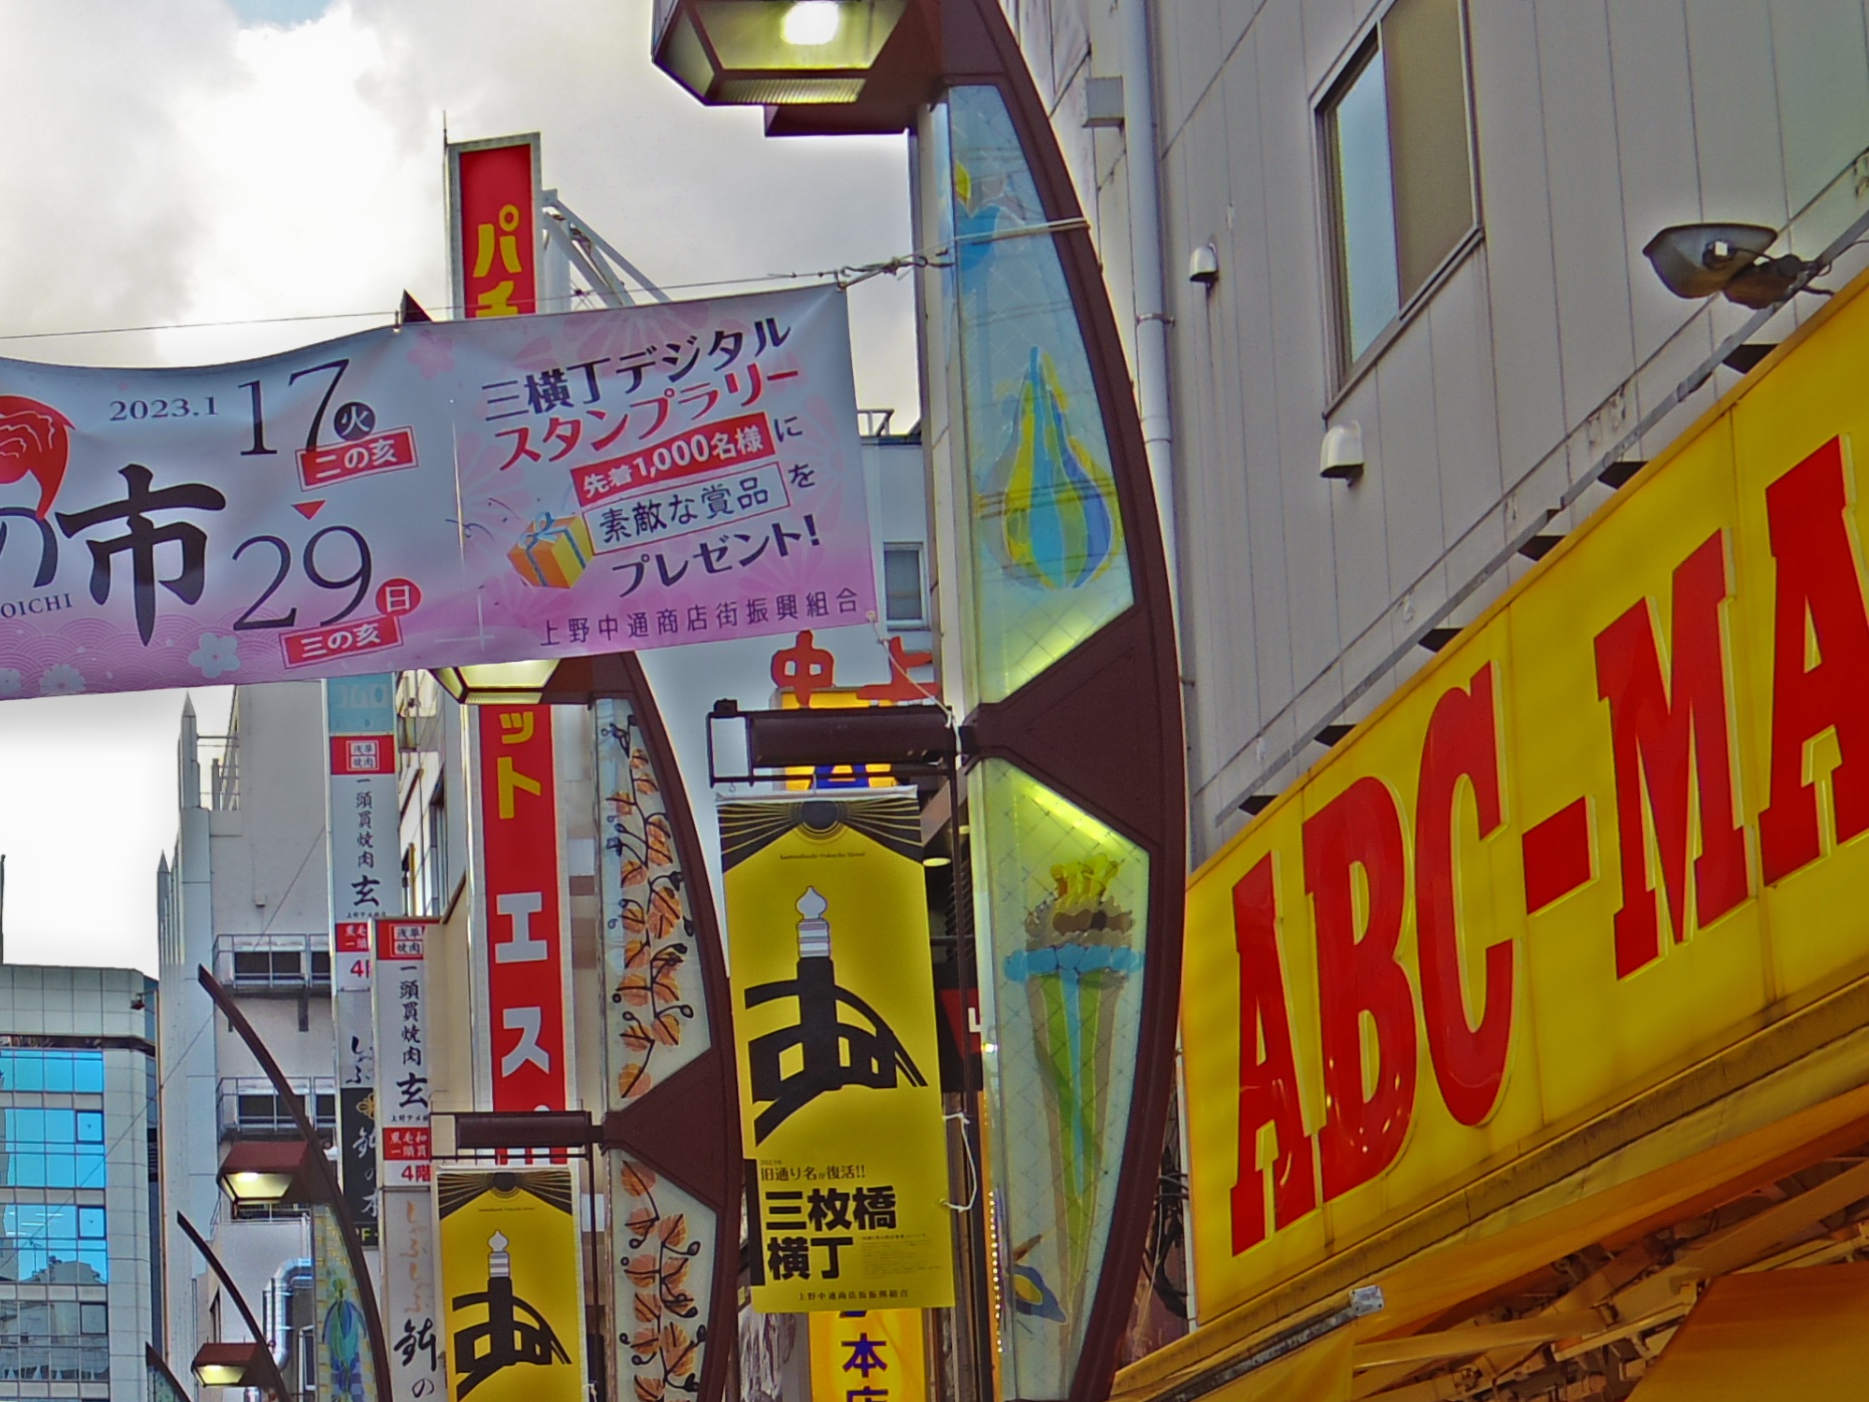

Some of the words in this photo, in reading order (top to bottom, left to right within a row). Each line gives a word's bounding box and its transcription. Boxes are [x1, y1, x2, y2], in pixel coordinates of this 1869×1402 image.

[109, 396, 219, 422] 2023.1
[238, 359, 350, 457] 17
[340, 404, 370, 435] 火
[482, 316, 792, 423] 三横丁デジタル
[495, 363, 800, 471] スタンプラリー
[313, 438, 403, 482] 二の亥
[233, 524, 375, 633] 29
[386, 583, 413, 613] 日
[612, 513, 822, 598] プレゼント!
[299, 622, 388, 661] 三の亥
[540, 586, 860, 648] 上野中通商店街振興組合
[355, 777, 376, 870] 一頭買焼肉
[1230, 433, 1869, 1256] ABC-MA
[351, 874, 381, 908] 玄
[399, 964, 422, 1067] 一頭買焼肉
[396, 1073, 429, 1109] 玄
[765, 1185, 897, 1232] 三枚橋
[767, 1236, 854, 1281] 横丁
